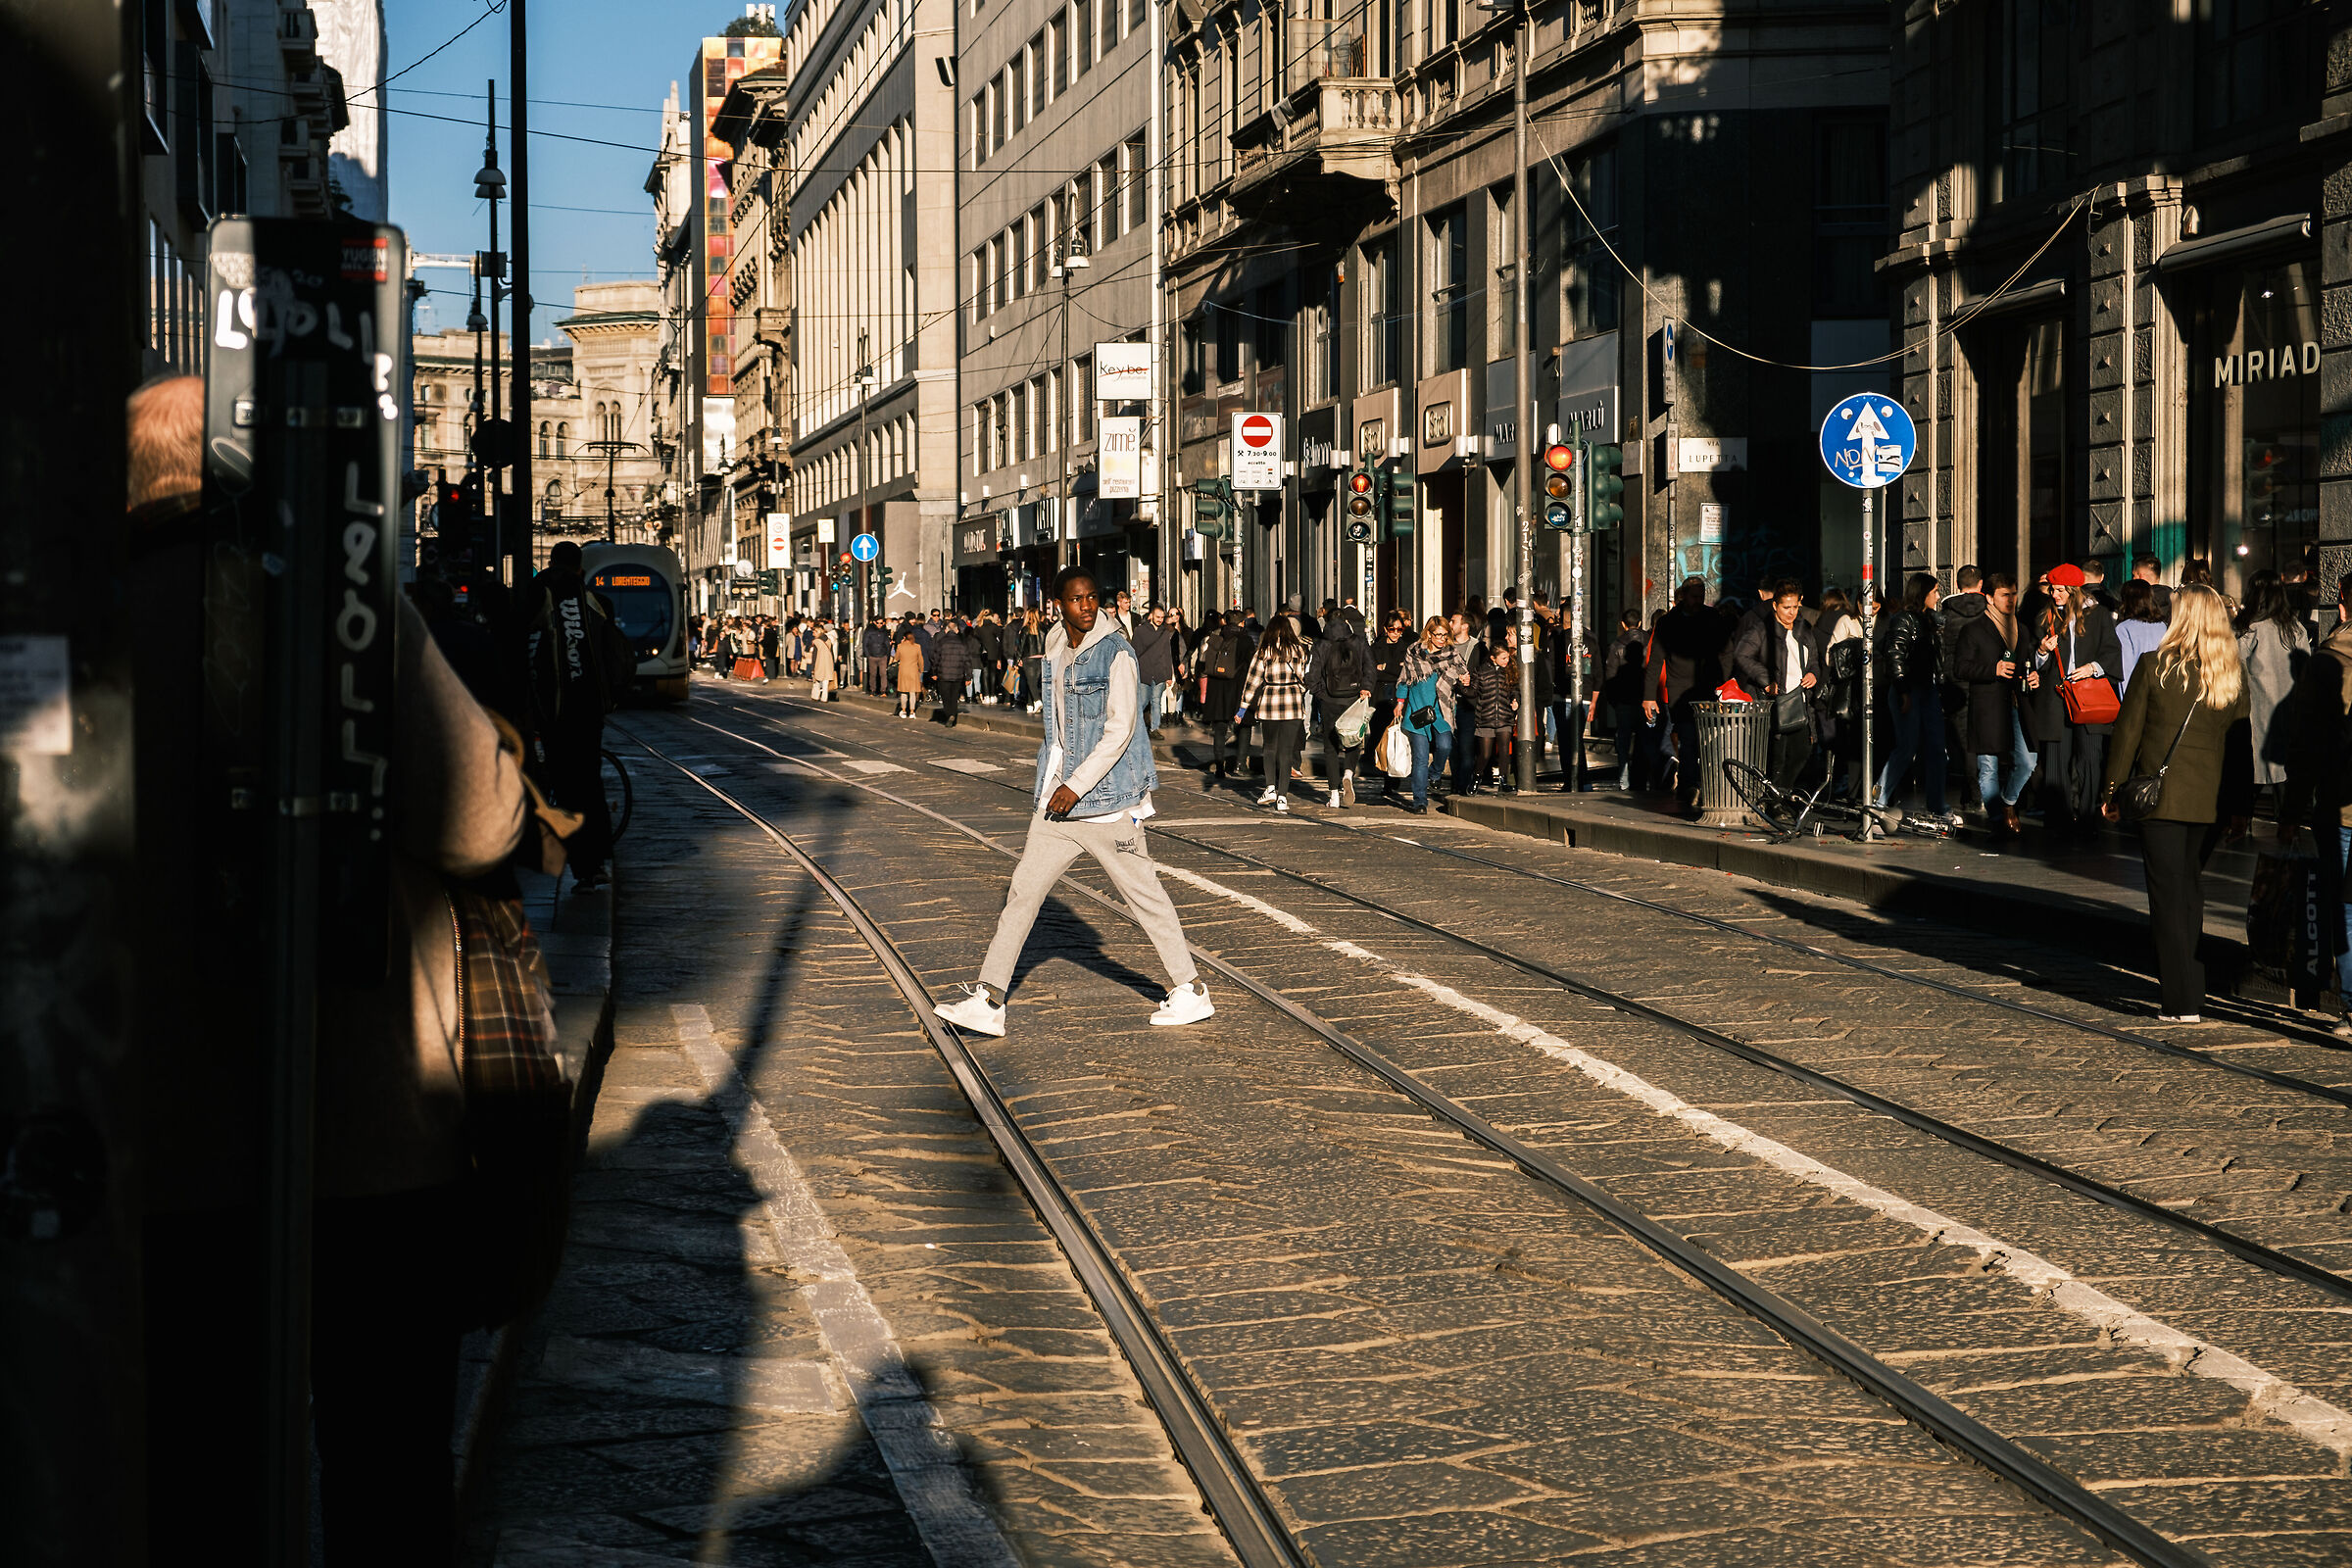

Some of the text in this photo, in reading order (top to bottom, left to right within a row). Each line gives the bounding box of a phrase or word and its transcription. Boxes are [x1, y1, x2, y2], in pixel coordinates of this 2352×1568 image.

[1689, 454, 1738, 464] LUPETTA
[596, 576, 605, 587] 14
[559, 597, 584, 682] Wilson
[2306, 869, 2320, 977] ALCOTT
